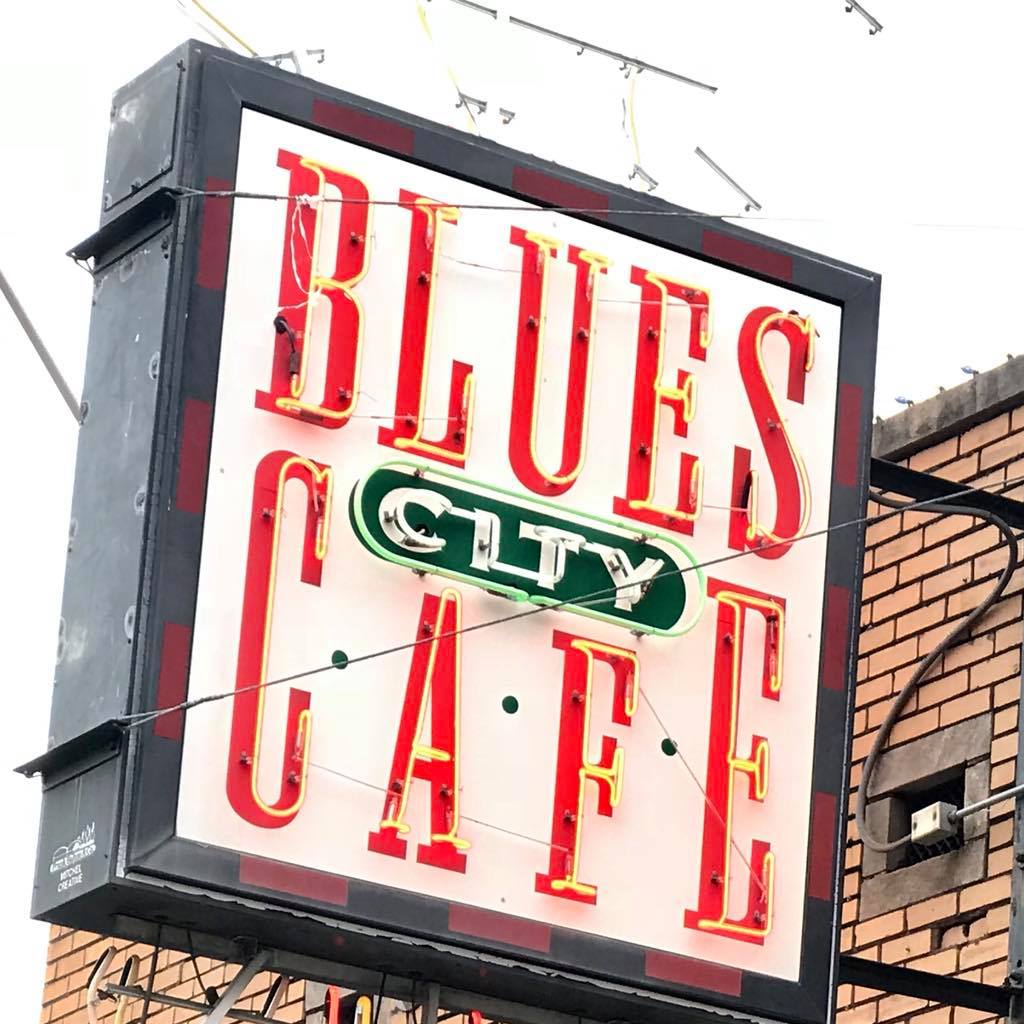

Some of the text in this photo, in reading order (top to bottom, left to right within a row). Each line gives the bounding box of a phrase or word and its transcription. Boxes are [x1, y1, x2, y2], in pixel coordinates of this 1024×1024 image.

[255, 148, 815, 560] BLUES
[379, 486, 665, 612] CITY
[226, 449, 787, 946] CAFE
